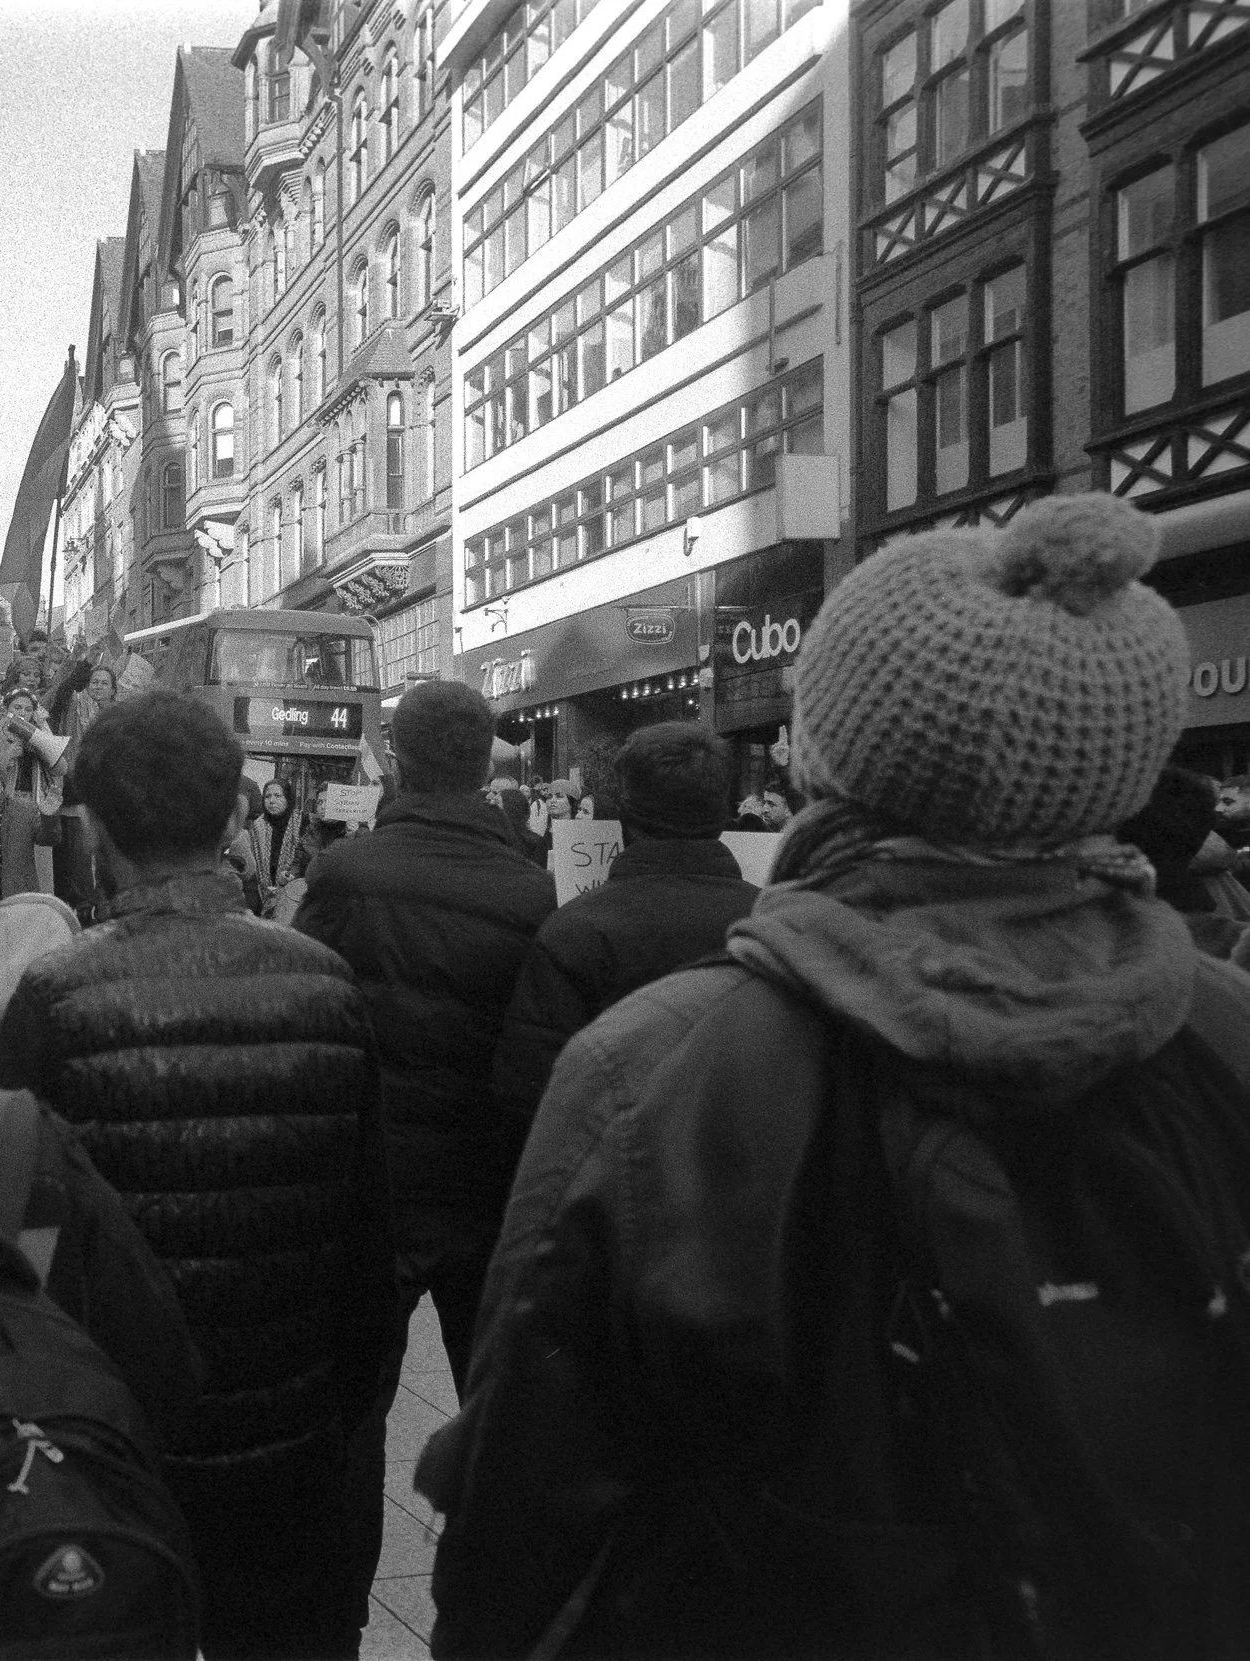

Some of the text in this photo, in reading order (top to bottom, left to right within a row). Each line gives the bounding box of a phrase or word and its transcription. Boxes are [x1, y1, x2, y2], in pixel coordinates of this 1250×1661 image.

[633, 622, 667, 635] Zizzi
[732, 614, 801, 665] Cubo
[1186, 656, 1247, 698] OU
[271, 707, 309, 725] Gedling
[331, 708, 348, 728] 44
